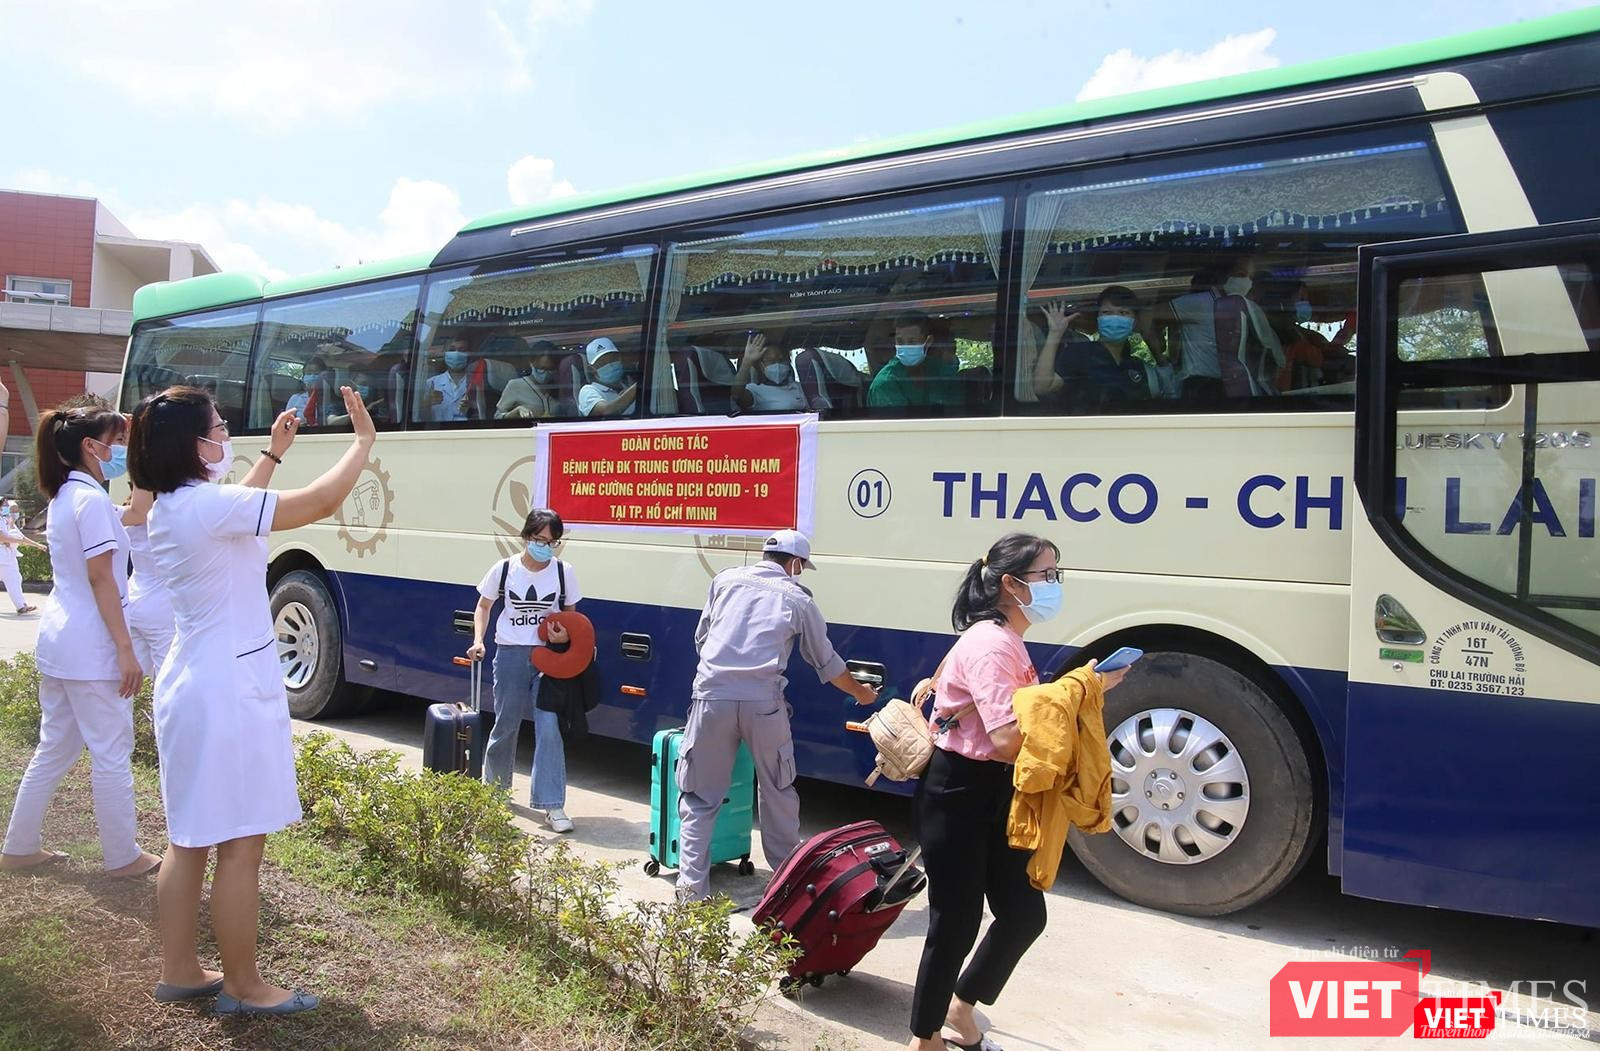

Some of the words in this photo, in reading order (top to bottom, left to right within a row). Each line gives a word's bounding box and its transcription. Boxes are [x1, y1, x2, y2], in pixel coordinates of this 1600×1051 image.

[621, 434, 651, 451] ĐOÀN
[653, 434, 684, 451] CÔNG
[687, 433, 709, 450] TÁC
[562, 459, 589, 477] BỆNH
[591, 458, 614, 477] VIỆN
[617, 460, 631, 474] ĐK
[634, 460, 669, 474] TRUNG
[672, 458, 703, 474] ƯƠNG
[706, 454, 747, 475] QUẢNG
[751, 458, 781, 473] NAM
[570, 480, 596, 496] TĂNG
[598, 479, 634, 497] CƯỜNG
[636, 478, 674, 497] CHỐNG
[676, 483, 703, 500] DỊCH
[706, 483, 741, 498] COVID
[753, 483, 769, 498] 19
[857, 480, 884, 508] 01
[610, 505, 626, 521] TẠI
[629, 505, 643, 519] TP.
[664, 503, 683, 520] CHÍ
[685, 506, 717, 521] MINH
[932, 472, 1159, 524] THACO
[1445, 477, 1596, 538] LAI
[1436, 636, 1447, 646] TY
[1443, 624, 1462, 639] TNHH
[1462, 621, 1479, 631] MTV
[1467, 637, 1487, 649] 16T
[1465, 656, 1489, 668] 47N
[1430, 669, 1448, 679] CHU
[1451, 671, 1465, 680] LAI
[1468, 672, 1506, 684] TRƯỜNG
[1508, 674, 1525, 686] HẢI
[1430, 679, 1445, 688] ĐT:
[1448, 681, 1473, 691] 0235
[1476, 683, 1525, 696] 3567.123
